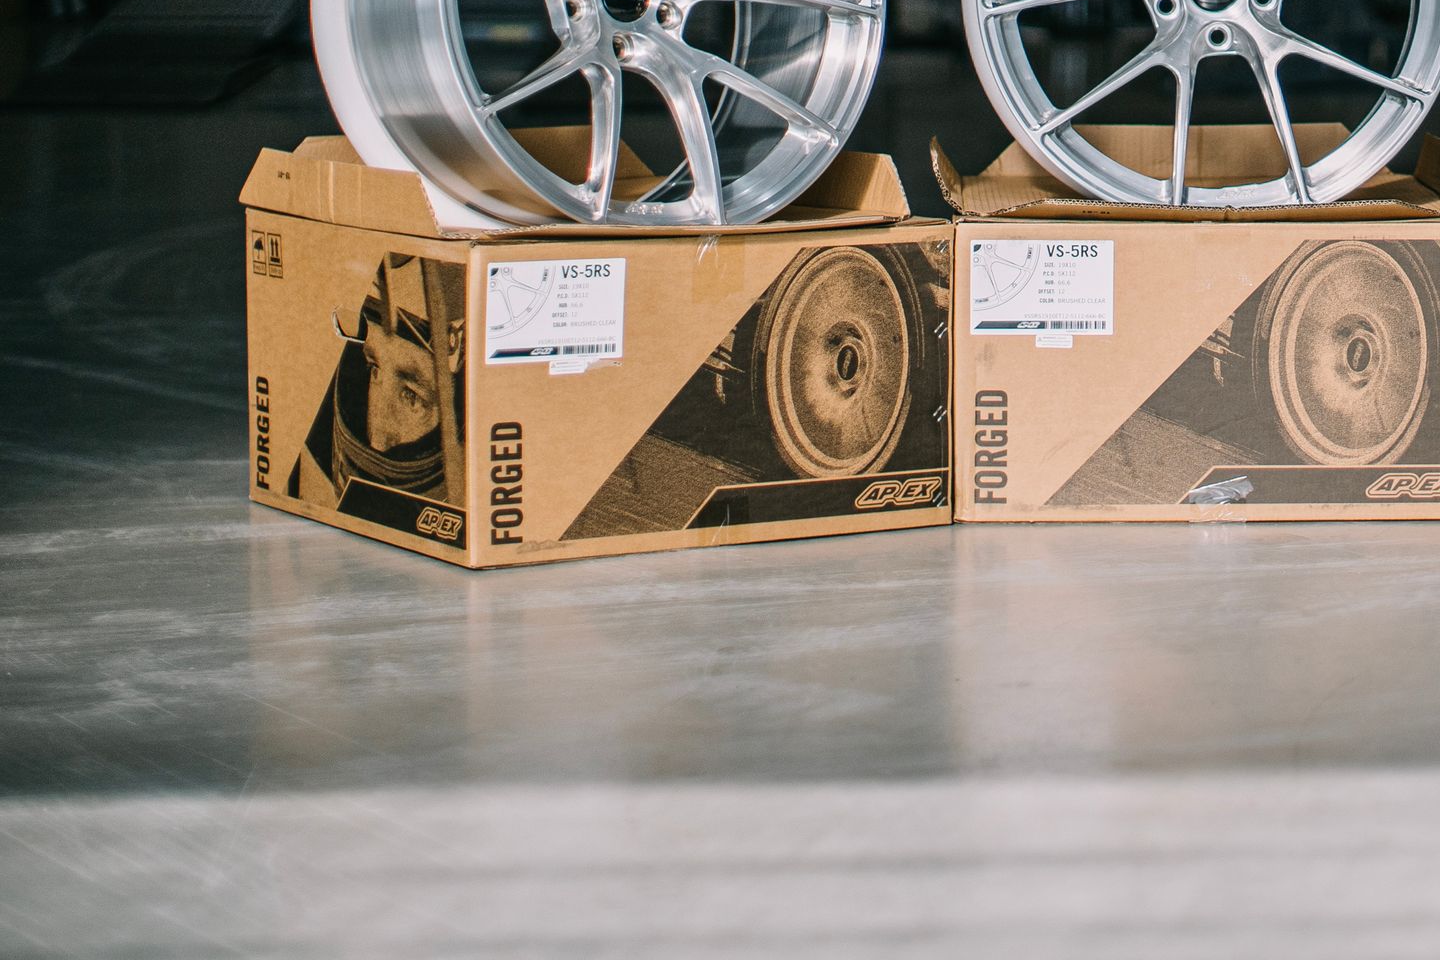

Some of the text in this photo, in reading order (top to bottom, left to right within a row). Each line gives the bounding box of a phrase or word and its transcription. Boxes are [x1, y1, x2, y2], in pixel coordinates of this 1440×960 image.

[1047, 245, 1098, 258] VS-5RS
[562, 264, 611, 278] VS-5RS
[256, 375, 270, 490] FORGED
[974, 390, 1008, 504] FORGED
[490, 421, 524, 545] FORGED
[858, 479, 940, 506] APEX
[419, 508, 461, 537] APEX
